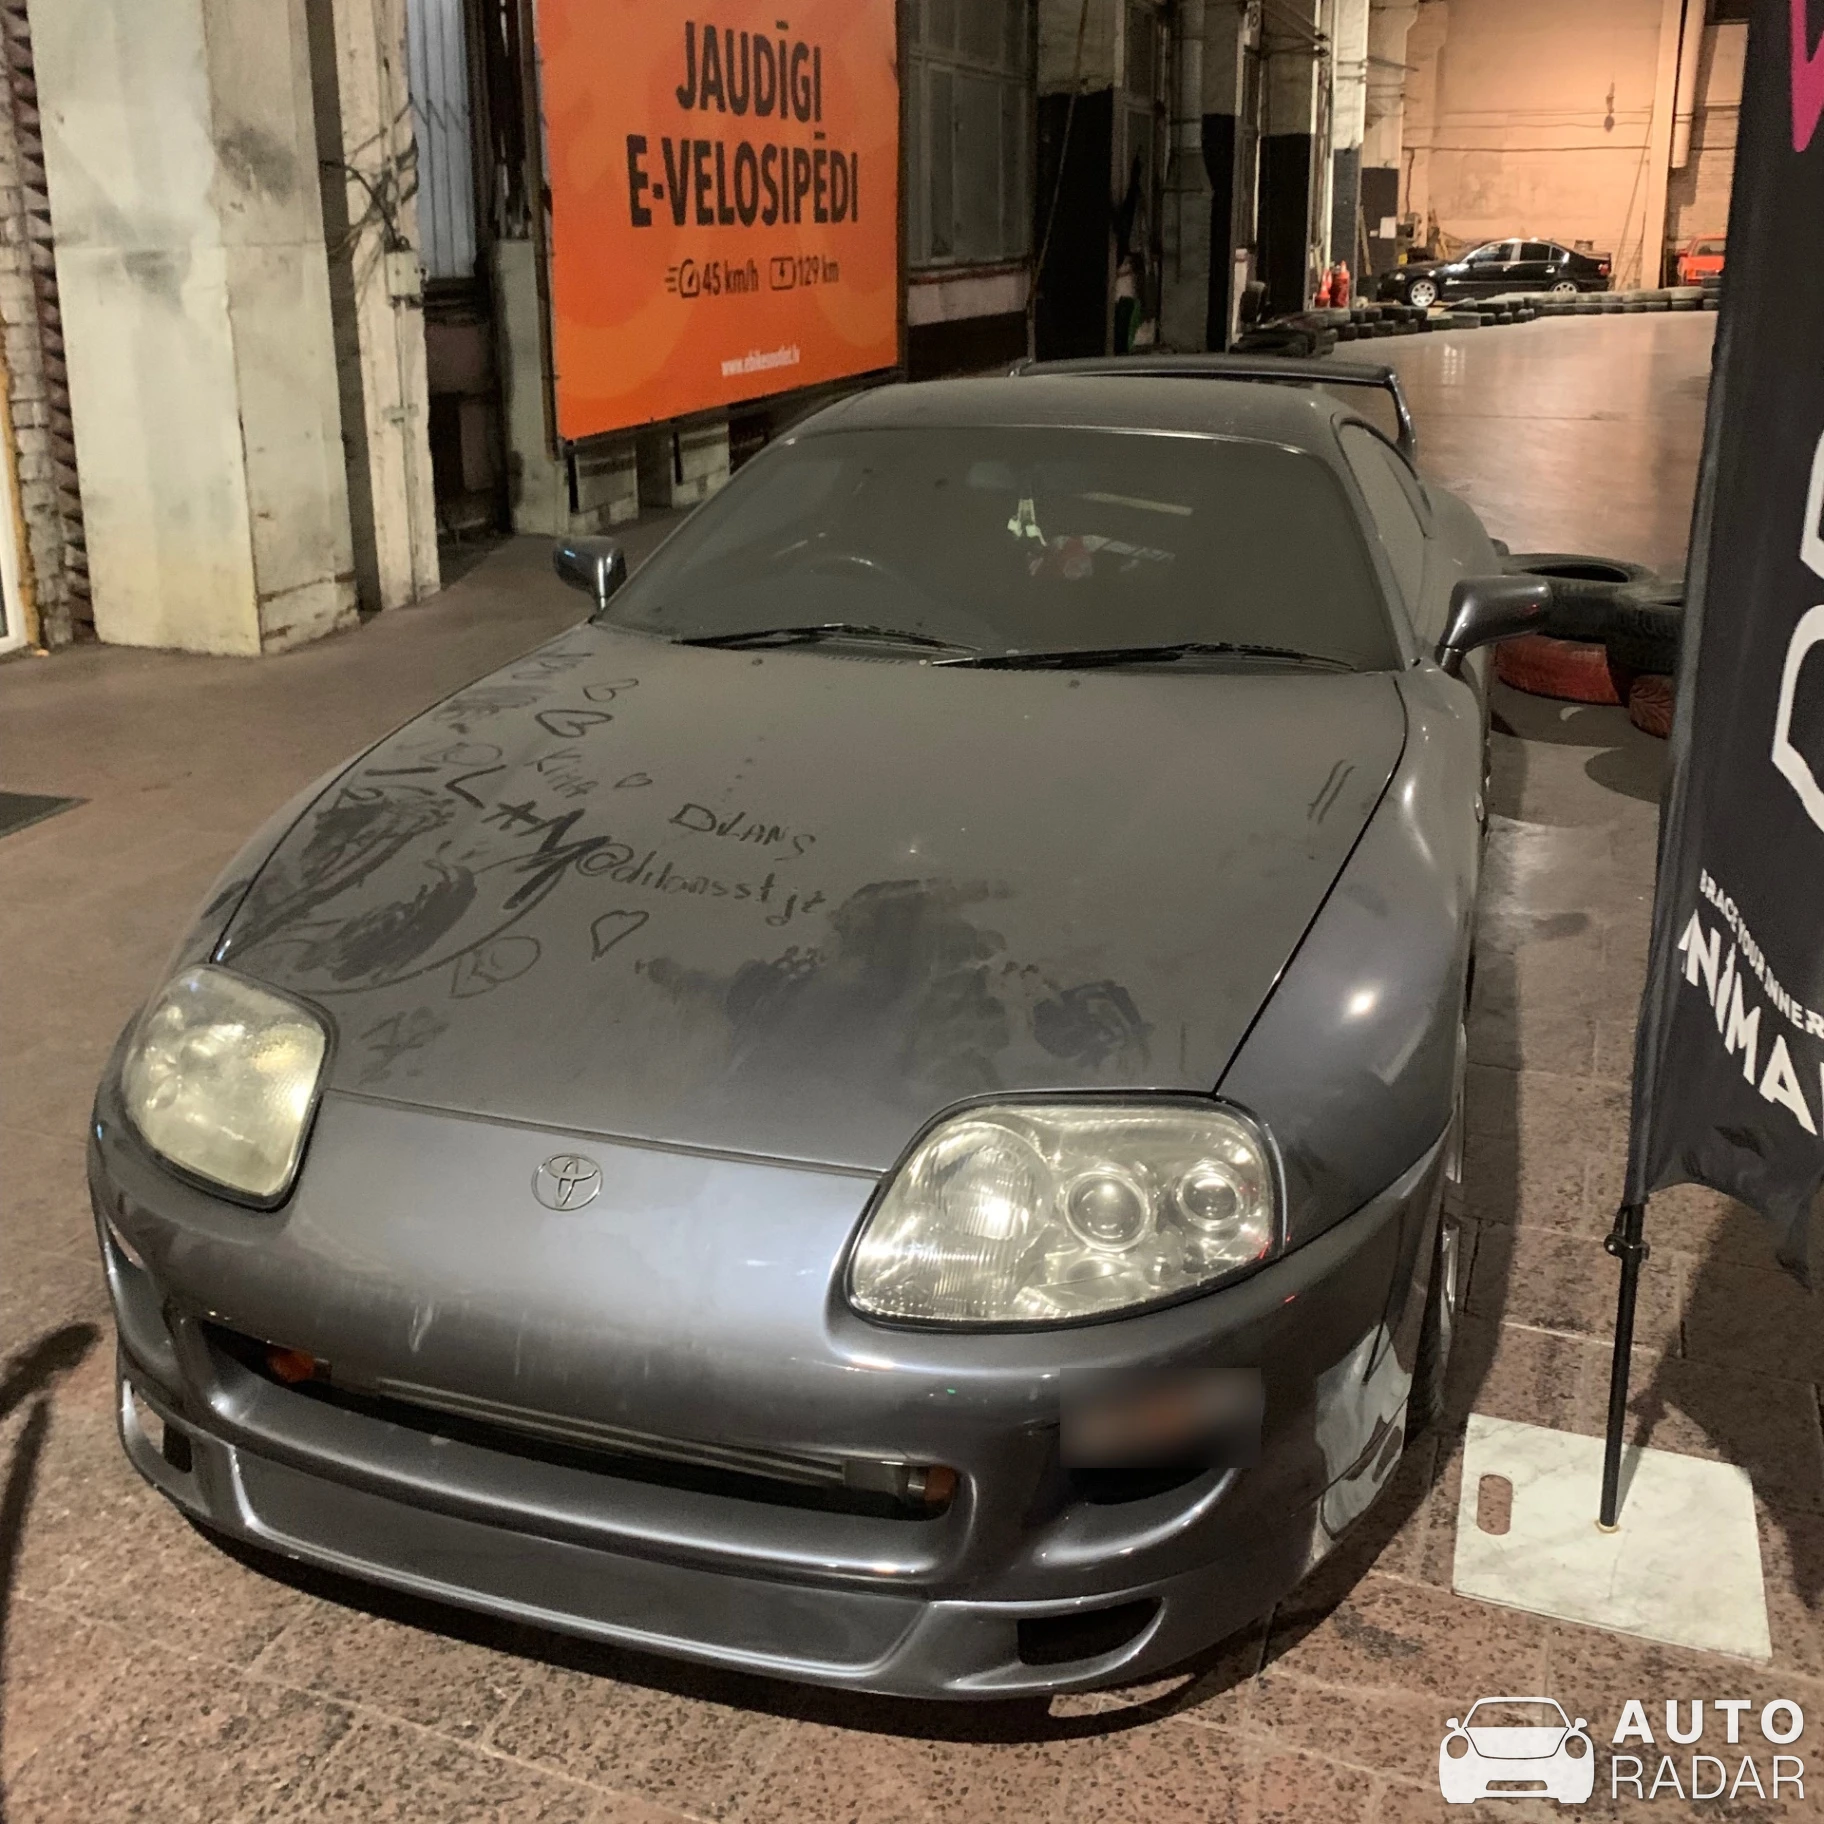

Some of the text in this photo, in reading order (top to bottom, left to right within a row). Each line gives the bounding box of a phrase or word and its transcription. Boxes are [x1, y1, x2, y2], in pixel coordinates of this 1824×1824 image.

[676, 20, 822, 123] JAUDĪGI
[626, 131, 858, 228] E-VELOSIPĒDI
[702, 255, 839, 296] 45 km/h 129 km
[1678, 908, 1824, 1138] NIMA
